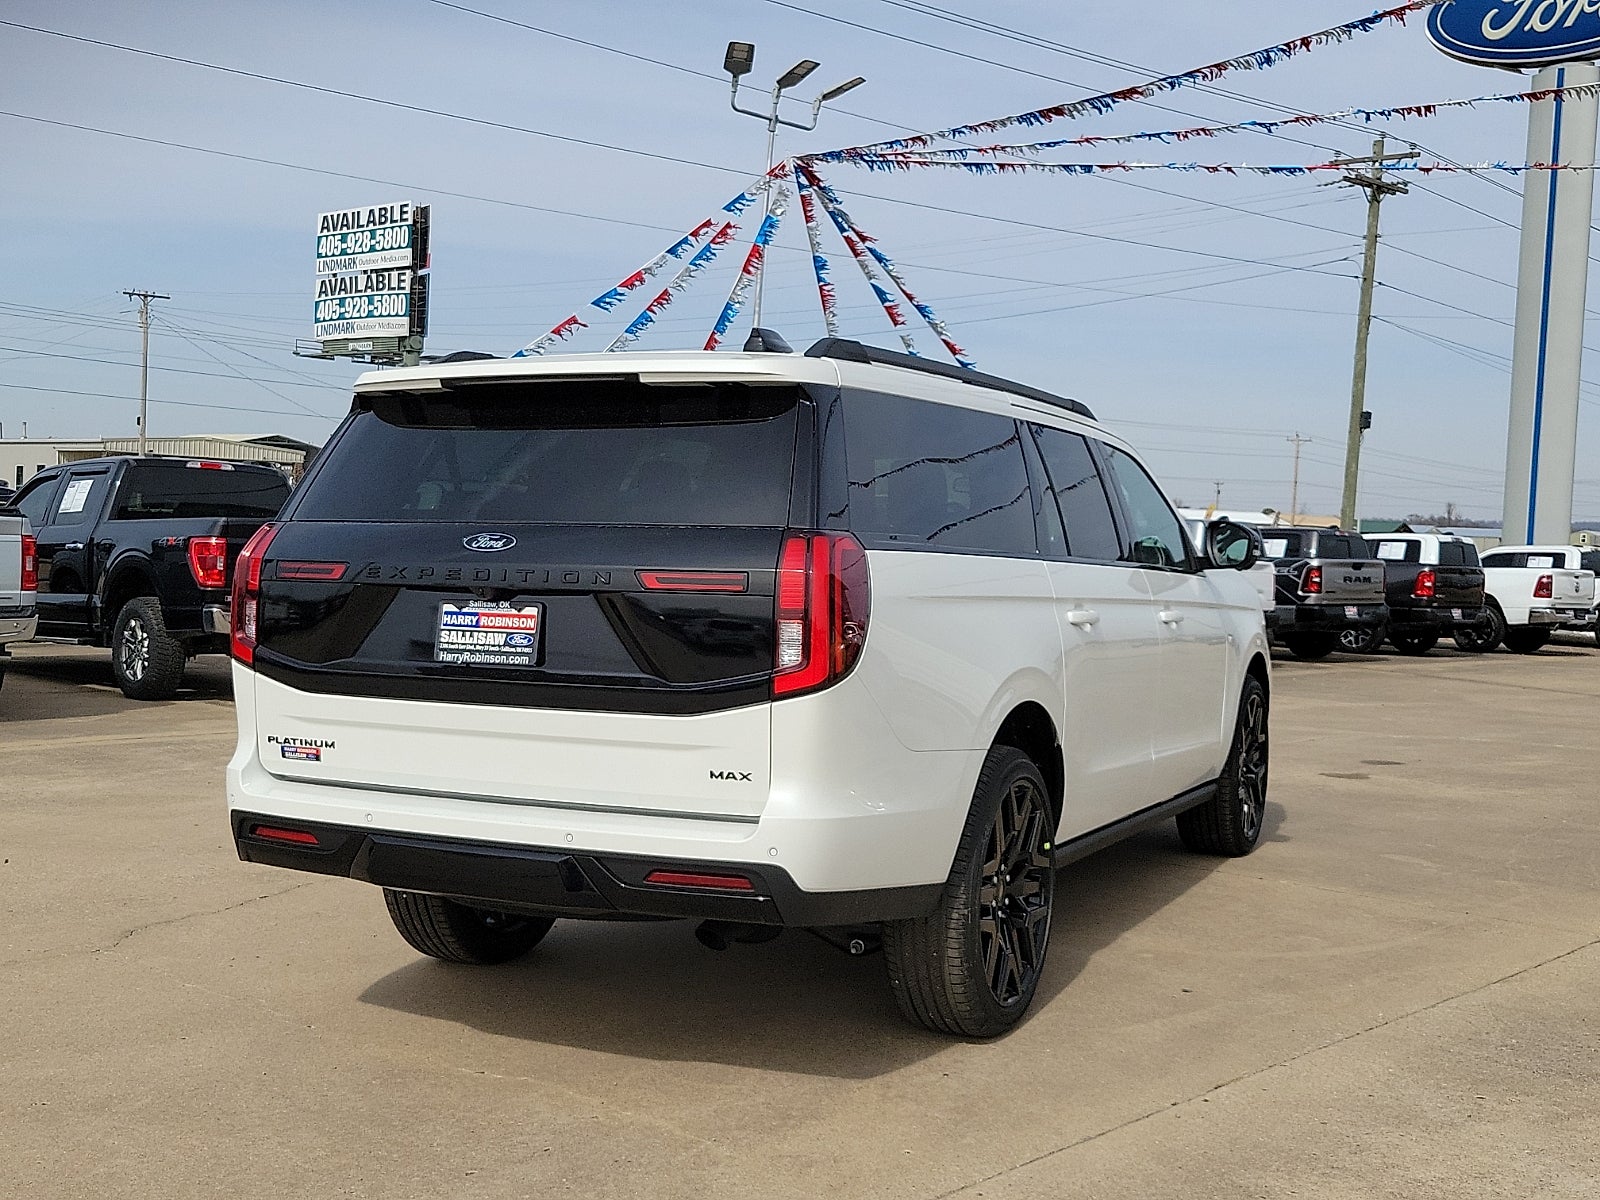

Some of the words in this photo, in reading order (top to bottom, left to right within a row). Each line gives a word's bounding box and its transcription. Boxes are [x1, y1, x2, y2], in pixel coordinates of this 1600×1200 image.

[319, 203, 410, 234] AVAILABLE
[318, 225, 409, 257] 405-928-5800
[318, 272, 407, 298] AVAILABLE
[316, 294, 406, 321] 405-928-5800
[472, 533, 504, 550] Ford
[365, 565, 612, 585] EXPEDITION
[1343, 576, 1372, 584] RAM
[469, 600, 498, 609] Sallisaw,
[499, 600, 511, 609] OK
[443, 615, 479, 626] HARRY
[480, 617, 535, 628] ROBINSON
[441, 630, 507, 646] SALLISAW
[440, 651, 529, 664] HarryRobinson.com
[267, 736, 336, 749] PLATINUM
[709, 769, 753, 782] MAX
